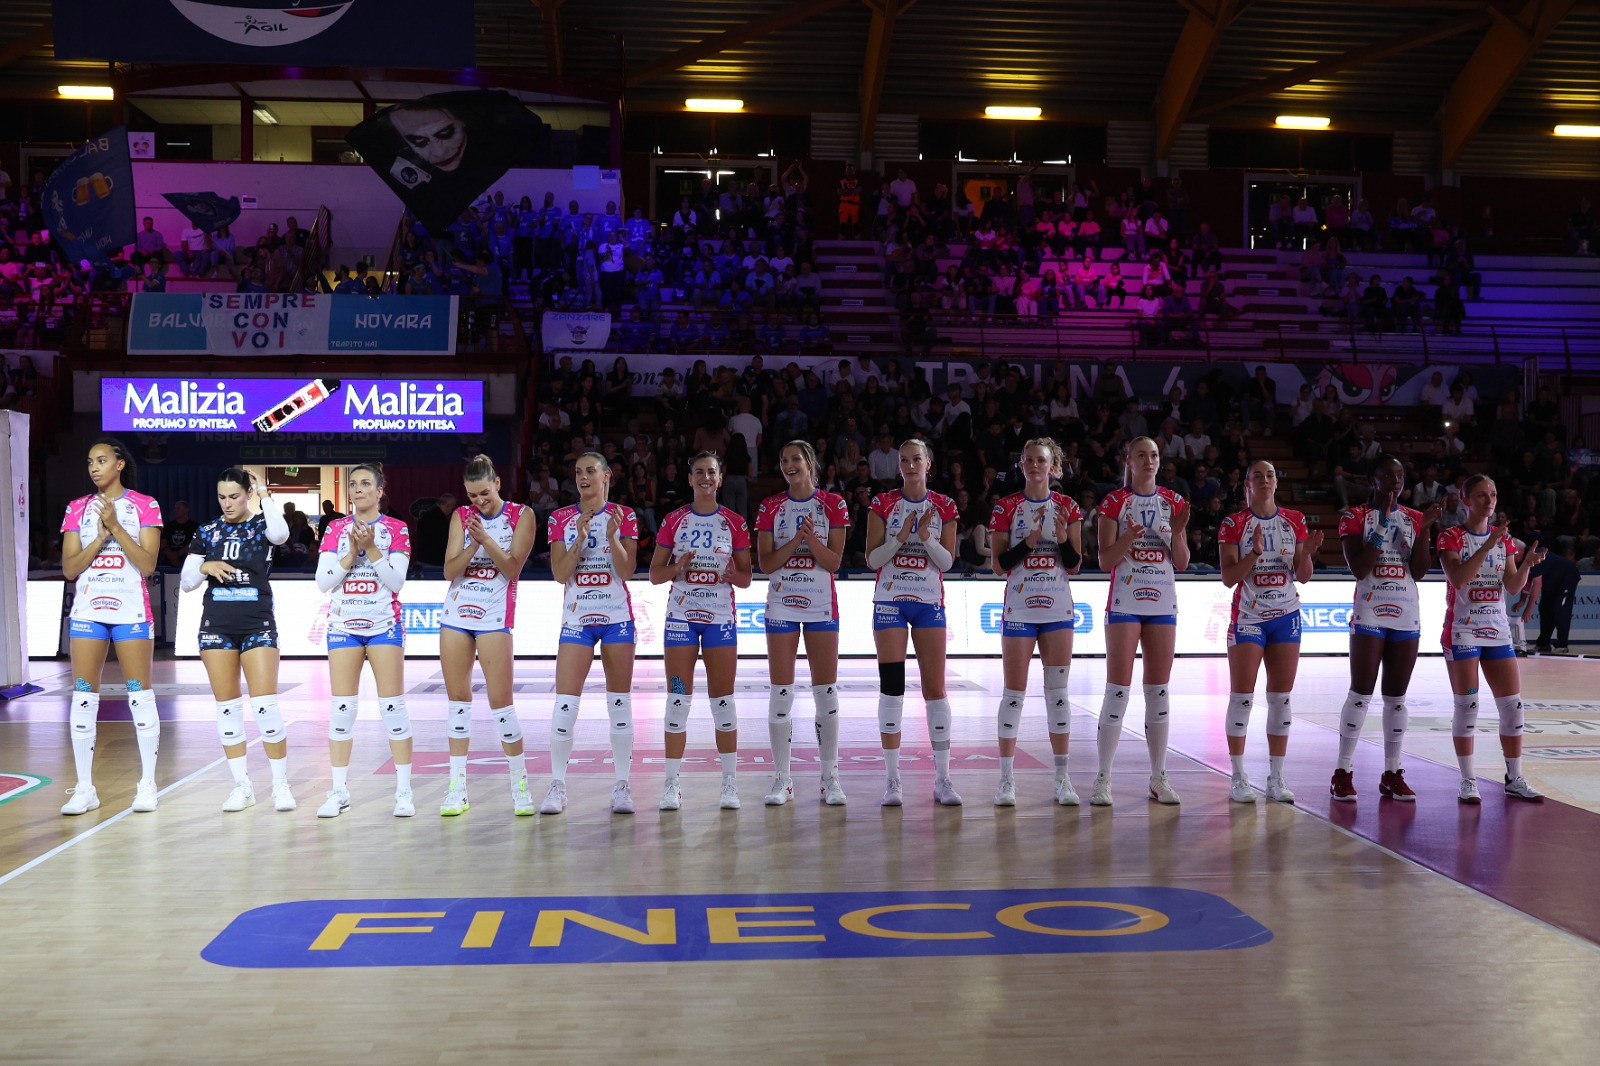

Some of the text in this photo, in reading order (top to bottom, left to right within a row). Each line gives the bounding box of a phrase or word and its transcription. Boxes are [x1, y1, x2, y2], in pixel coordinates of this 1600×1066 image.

[209, 293, 316, 309] SEMPRE
[233, 312, 288, 329] CON
[355, 314, 432, 329] NOVARA
[232, 331, 284, 348] VOI
[124, 381, 246, 415] Malizia
[344, 382, 465, 416] Malizia
[133, 418, 237, 429] PROFUMO D'INTESA
[353, 419, 456, 430] PROFUMO D'INTESA
[1139, 510, 1156, 528] 17
[587, 529, 597, 549] 5
[690, 530, 713, 549] 23
[1262, 533, 1275, 552] 11
[222, 541, 240, 561] 10
[1134, 551, 1162, 561] IGOR
[896, 556, 925, 567] IGOR
[1026, 557, 1055, 567] IGOR
[467, 567, 497, 578] IGOR
[1375, 567, 1405, 576] IGOR
[577, 574, 609, 584] IGOR
[1256, 575, 1284, 585] IGOR
[345, 582, 376, 592] IGOR
[1472, 590, 1499, 600] IGOR
[1291, 616, 1300, 630] 11
[307, 901, 1169, 951] FINECO
